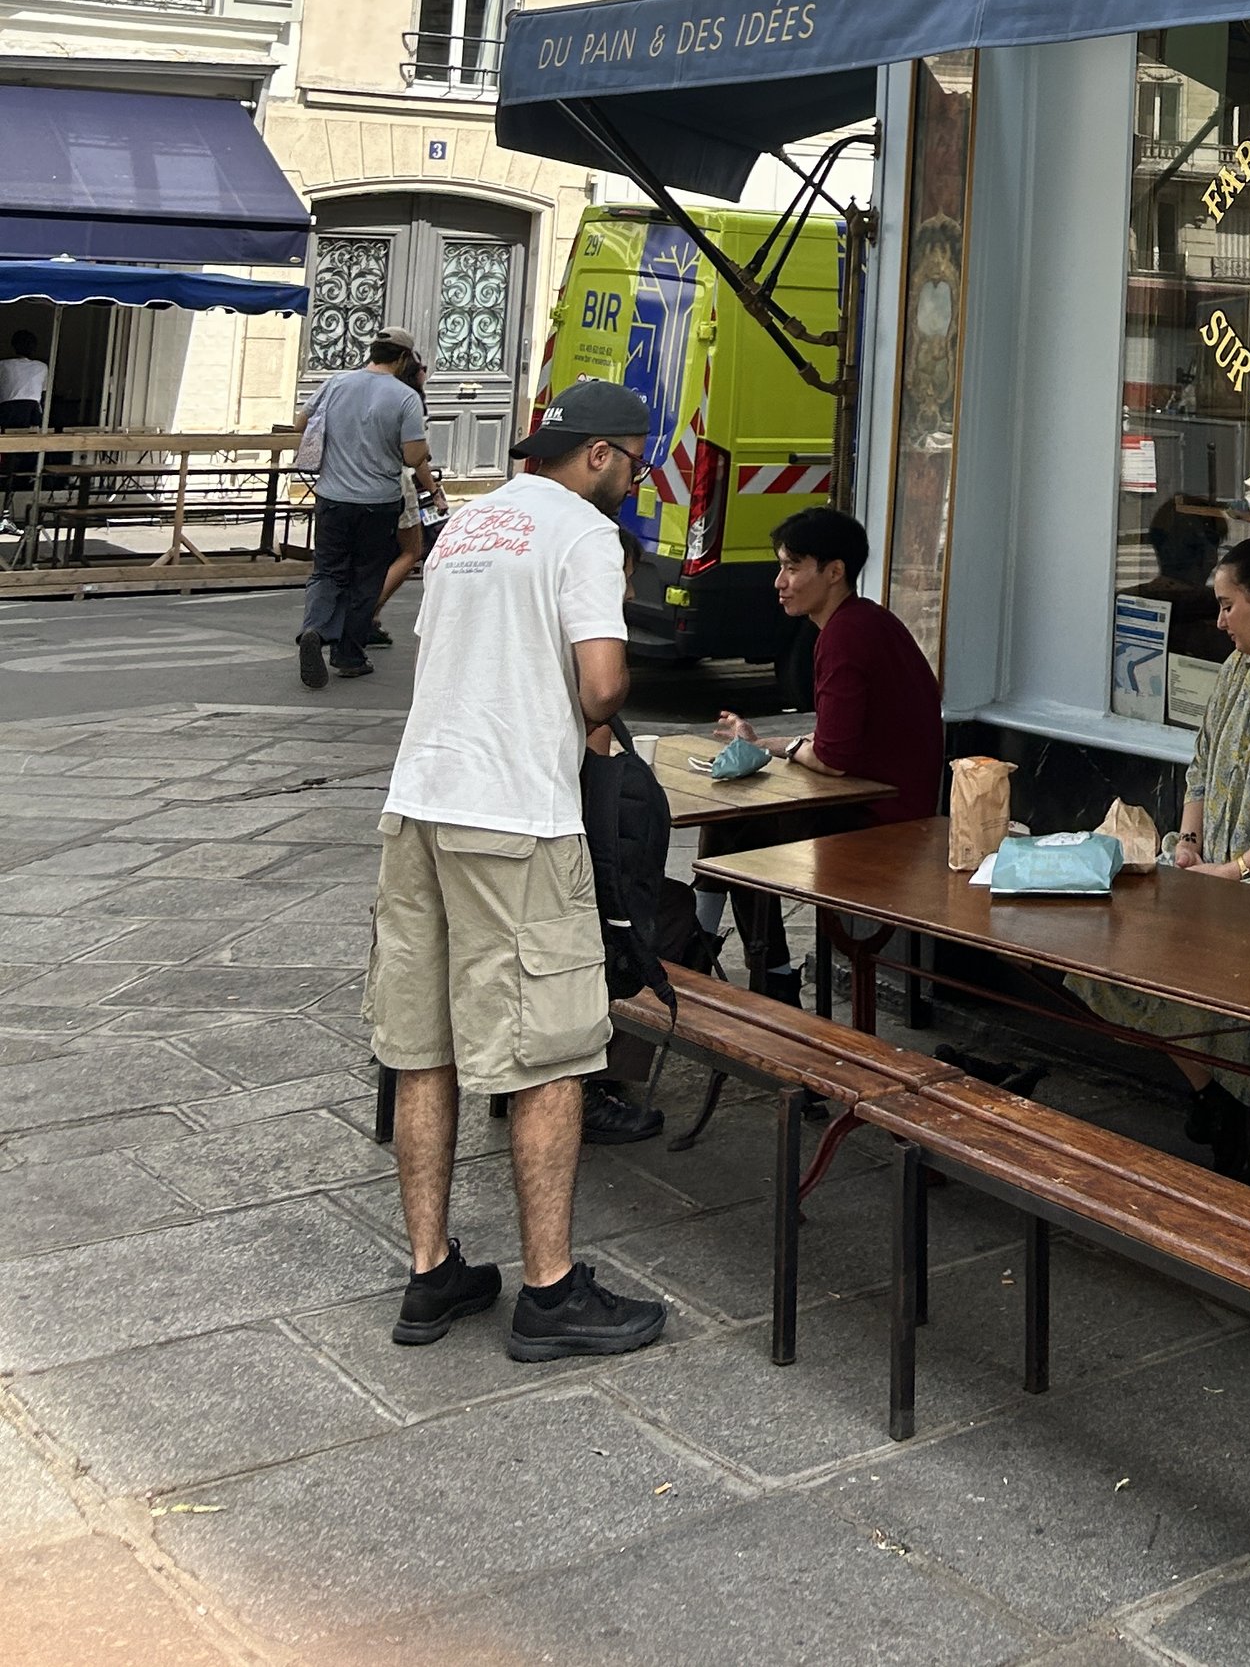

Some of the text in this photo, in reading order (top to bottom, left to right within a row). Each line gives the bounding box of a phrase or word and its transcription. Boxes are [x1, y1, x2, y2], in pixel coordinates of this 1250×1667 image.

[538, 36, 573, 70] DU
[580, 27, 637, 65] PAIN
[648, 24, 667, 58] &
[676, 16, 726, 55] DES
[431, 142, 443, 159] 3
[583, 234, 605, 256] 297
[581, 289, 622, 333] BIR
